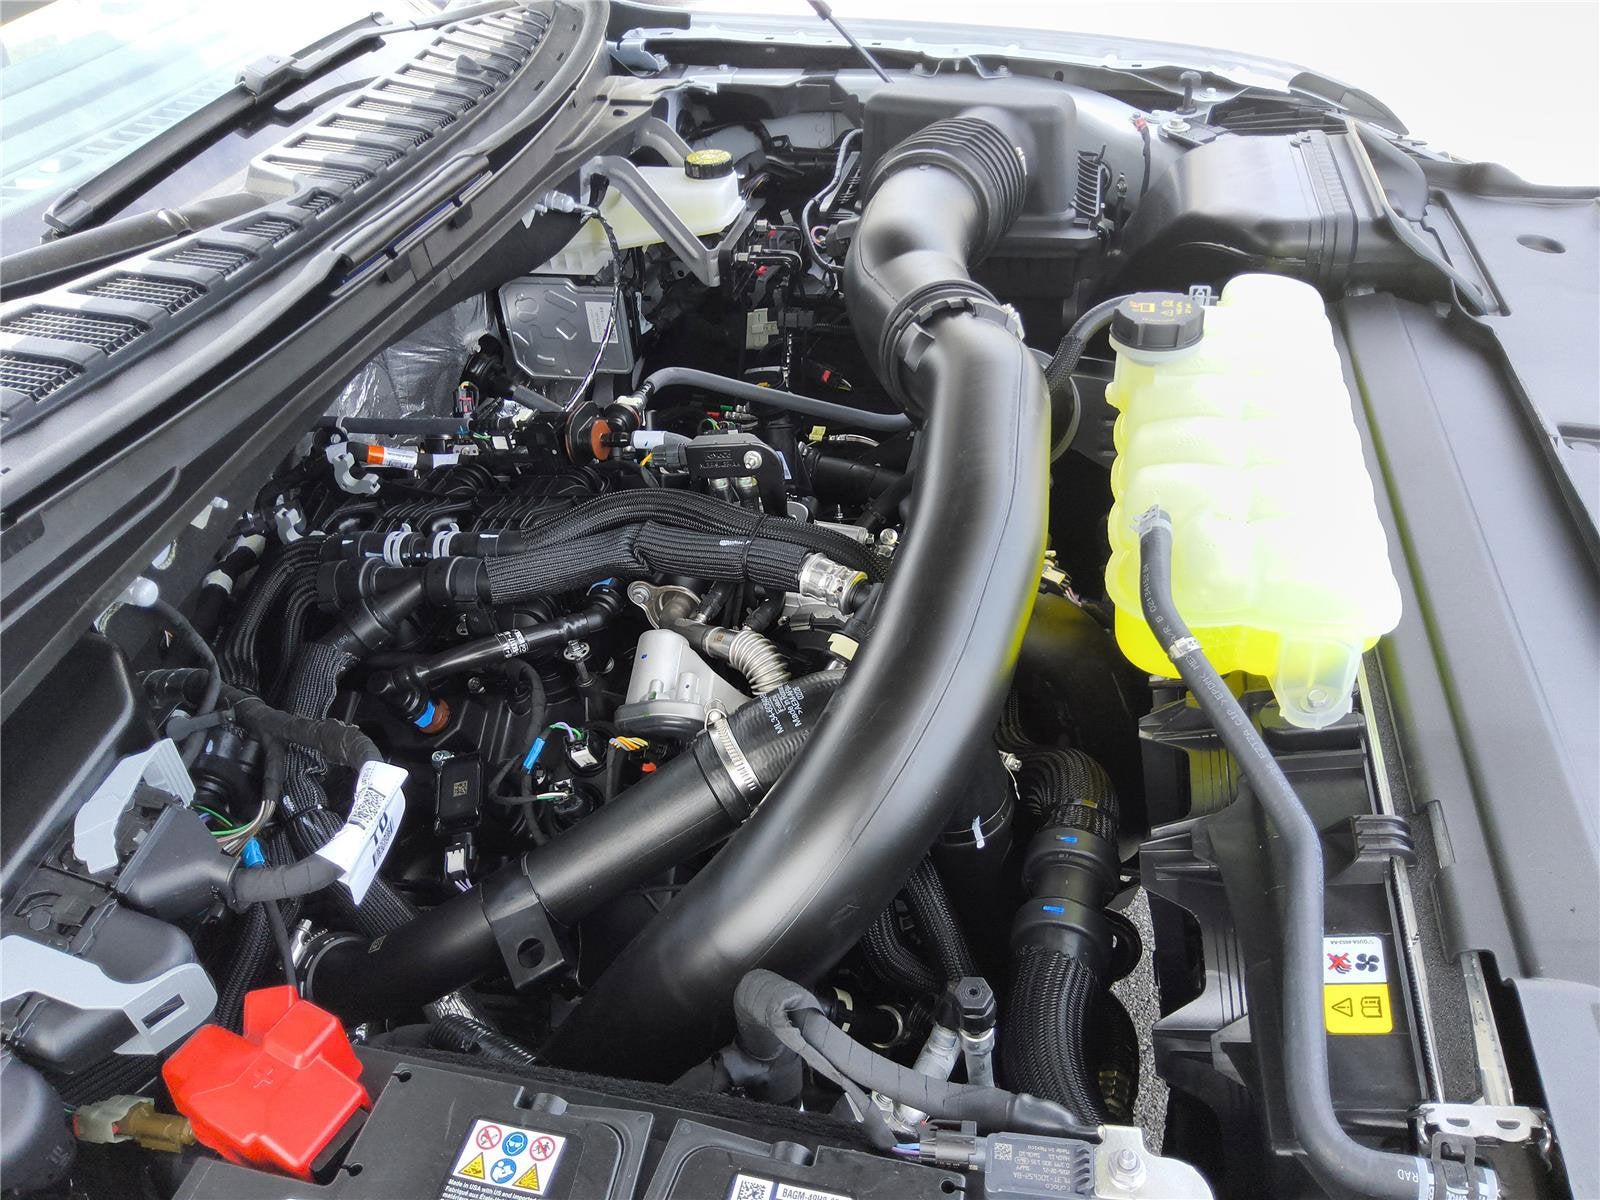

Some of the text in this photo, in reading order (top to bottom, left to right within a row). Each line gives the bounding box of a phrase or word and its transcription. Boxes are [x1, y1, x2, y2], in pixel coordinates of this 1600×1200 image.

[788, 705, 802, 728] Made
[1397, 1169, 1419, 1183] RAD
[448, 1179, 462, 1188] Made
[469, 1184, 481, 1192] USA
[481, 1186, 493, 1195] with
[502, 1191, 513, 1199] and
